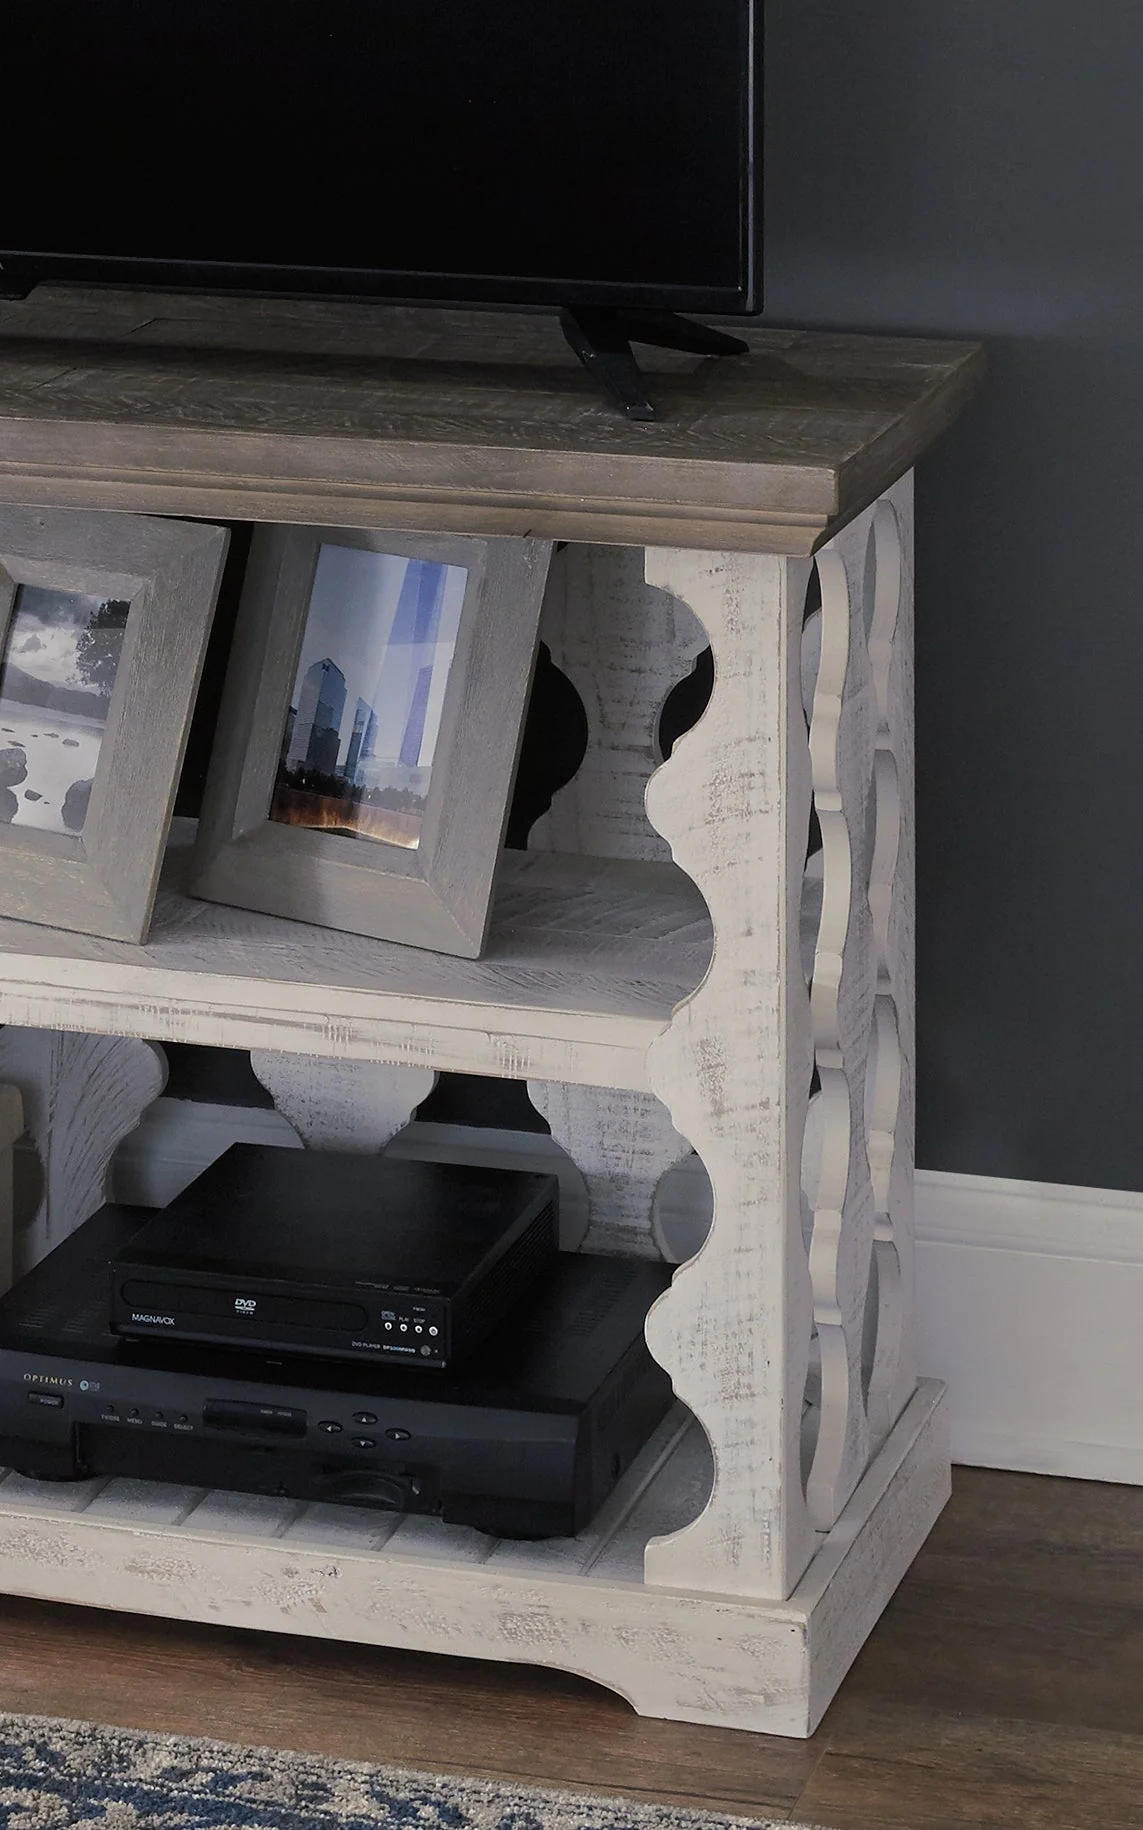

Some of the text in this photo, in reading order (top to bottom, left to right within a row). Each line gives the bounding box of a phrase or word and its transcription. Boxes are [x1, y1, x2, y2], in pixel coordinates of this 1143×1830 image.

[234, 1298, 257, 1308] DVD
[131, 1312, 176, 1326] MAGNAVOX
[23, 1373, 73, 1386] OPTIMUS
